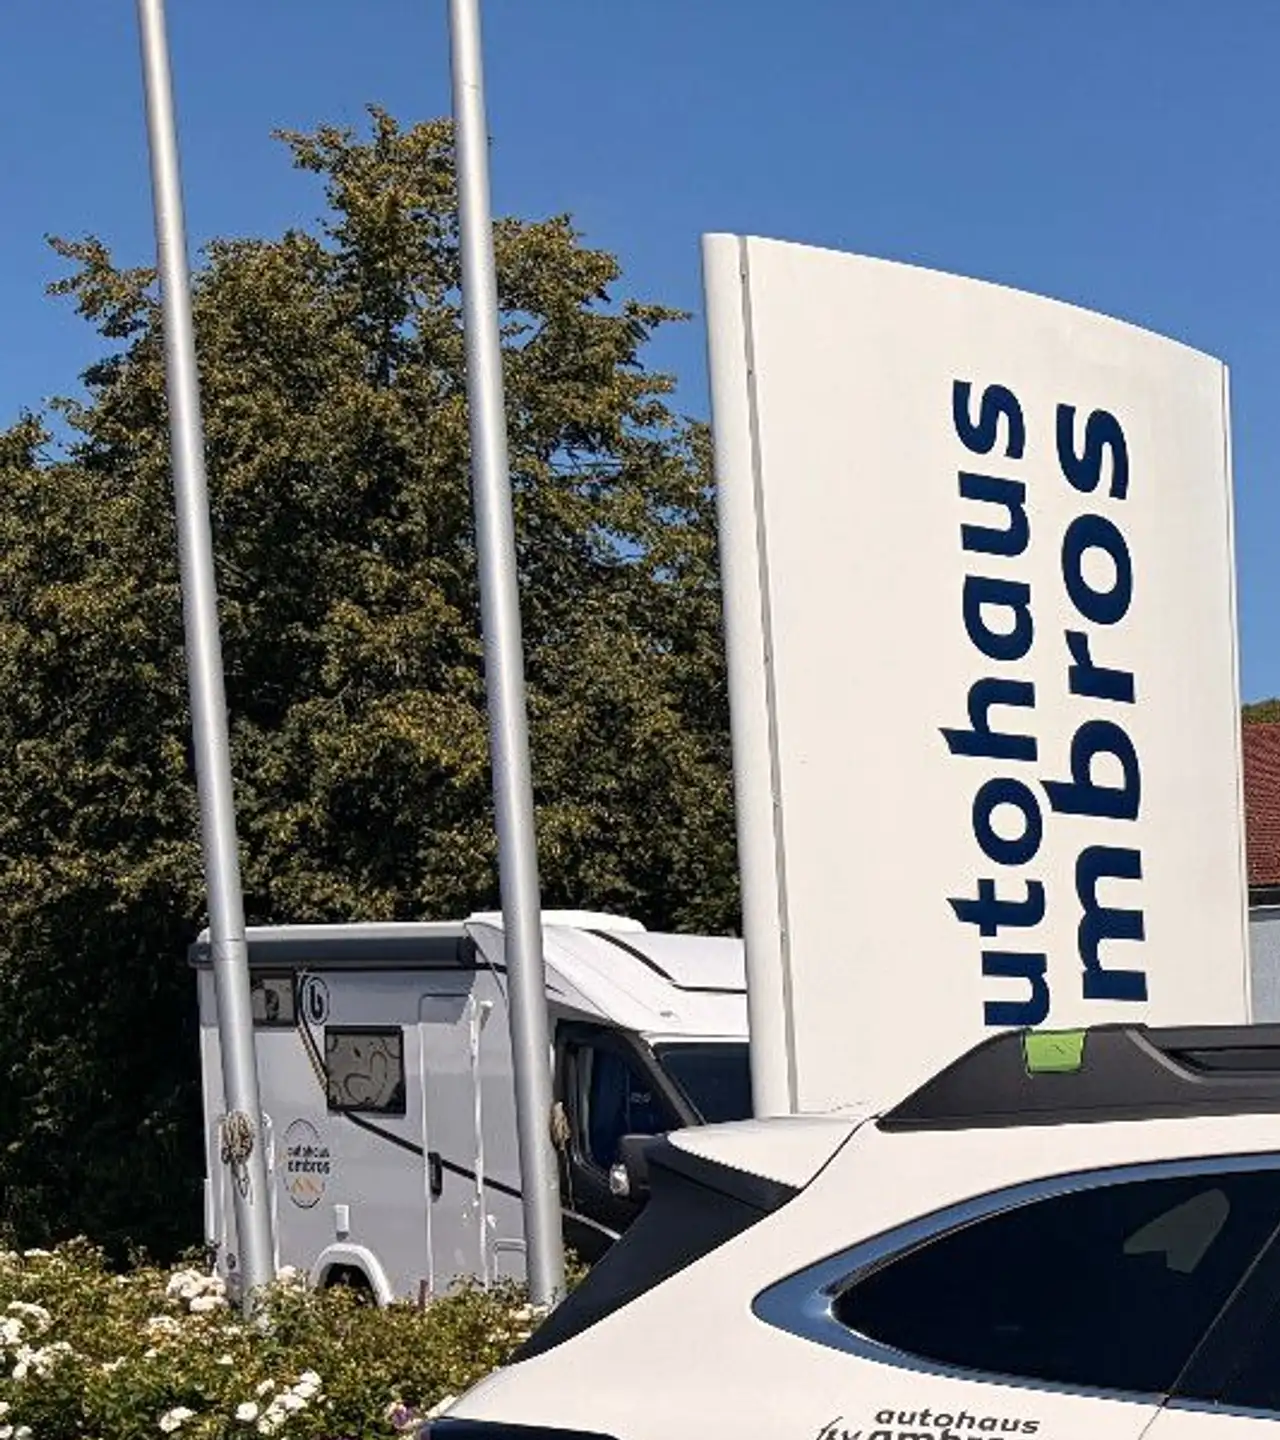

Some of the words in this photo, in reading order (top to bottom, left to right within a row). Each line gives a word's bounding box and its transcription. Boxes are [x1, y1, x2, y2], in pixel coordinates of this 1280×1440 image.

[937, 379, 1051, 1027] utohaus
[1039, 402, 1148, 1002] mbros
[874, 1408, 1041, 1435] autohaus
